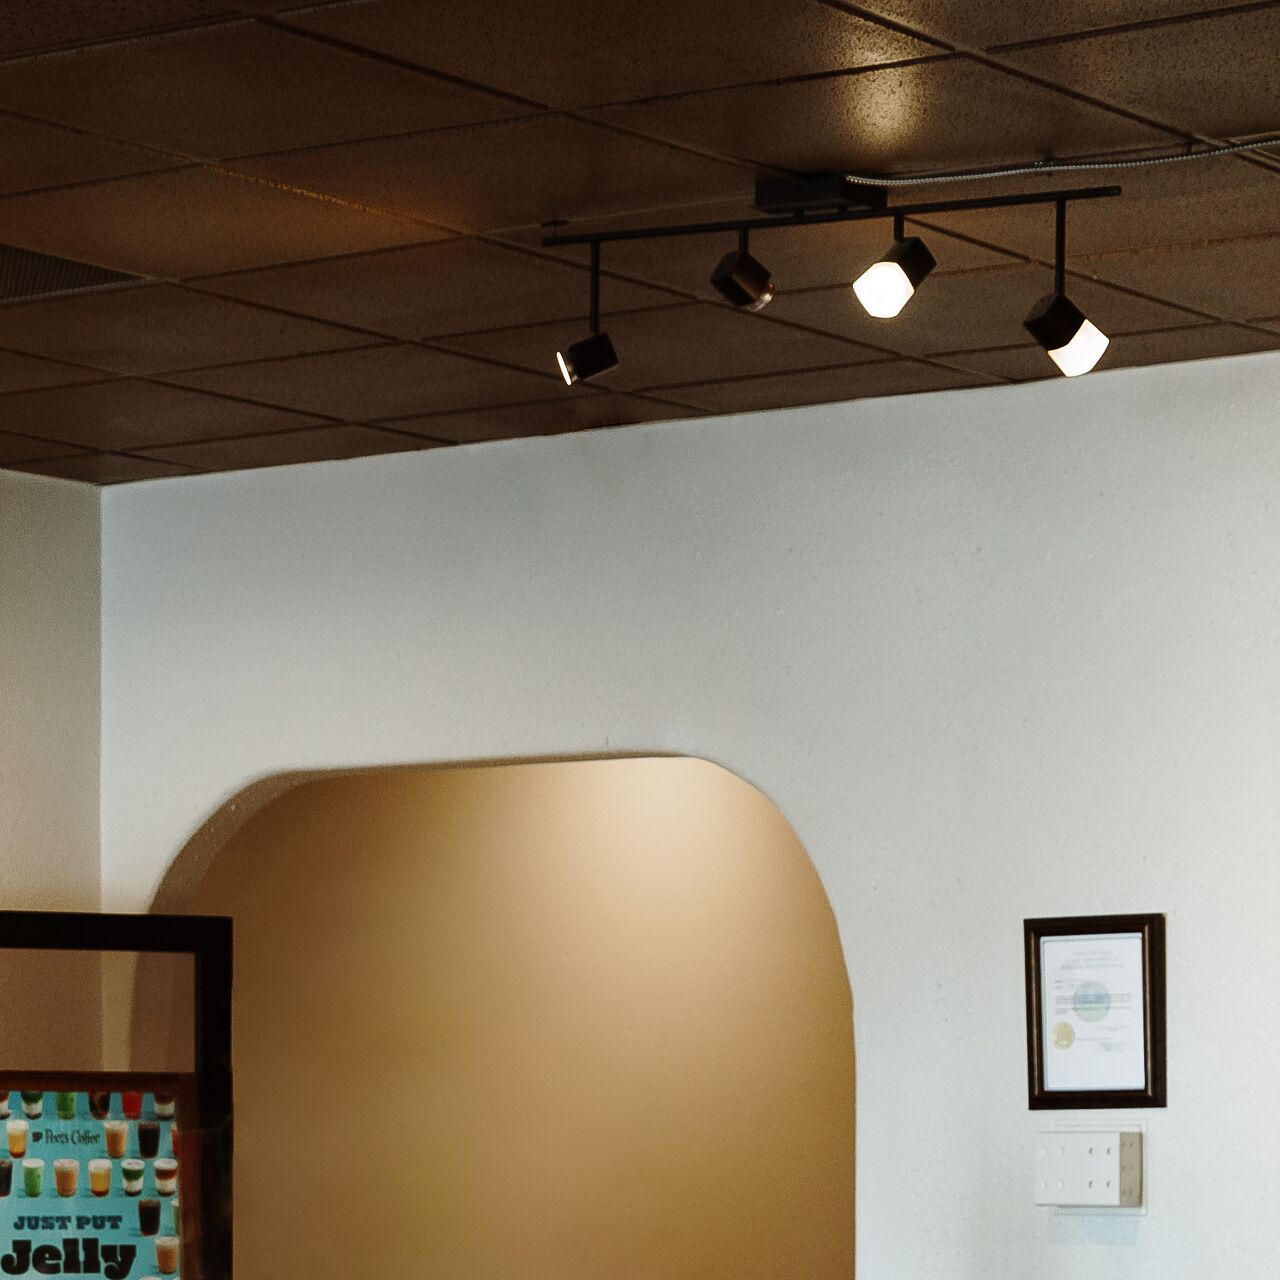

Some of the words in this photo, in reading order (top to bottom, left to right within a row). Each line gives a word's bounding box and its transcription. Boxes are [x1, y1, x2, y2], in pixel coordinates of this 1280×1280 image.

[13, 1216, 71, 1230] JUST
[76, 1216, 122, 1230] PUT
[0, 1238, 137, 1280] Jelly
